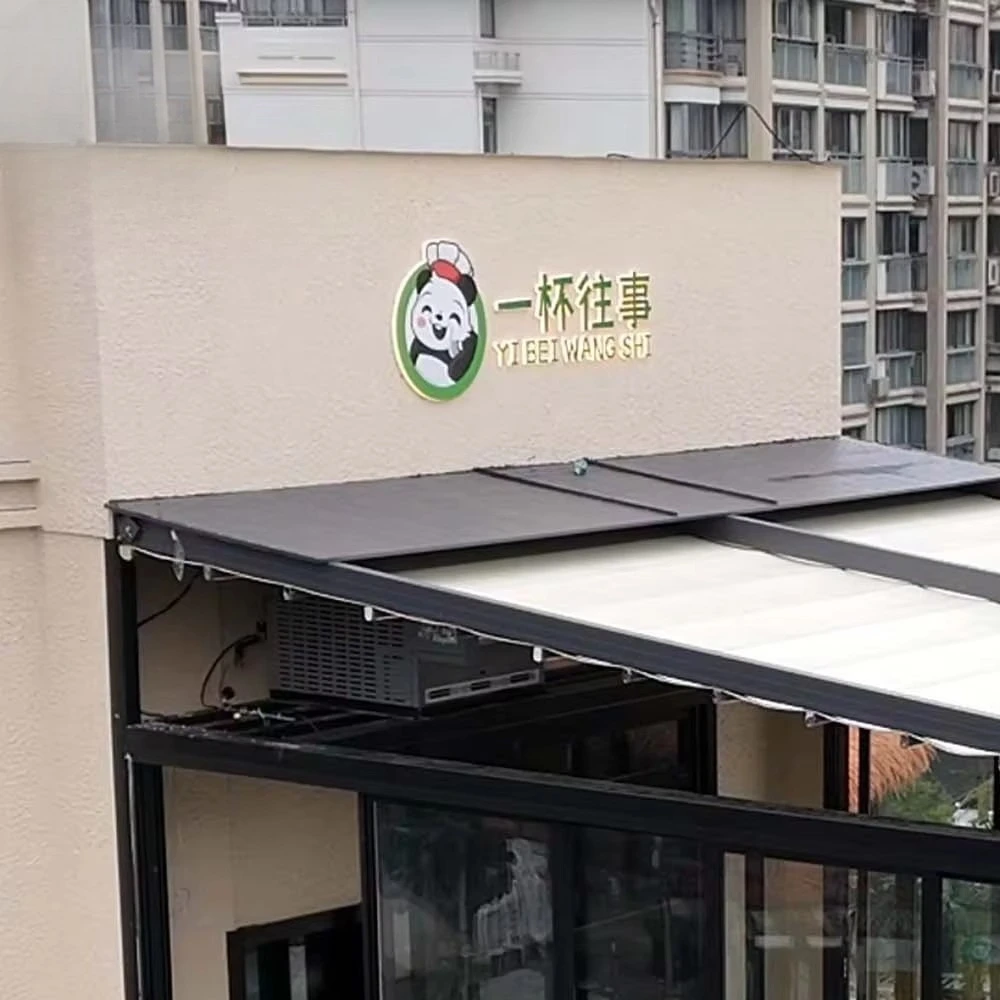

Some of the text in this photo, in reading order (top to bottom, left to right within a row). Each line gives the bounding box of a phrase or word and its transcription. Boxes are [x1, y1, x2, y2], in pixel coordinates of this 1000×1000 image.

[496, 270, 653, 333] 一杯往事
[495, 334, 653, 367] YI BEI WANG SHI
